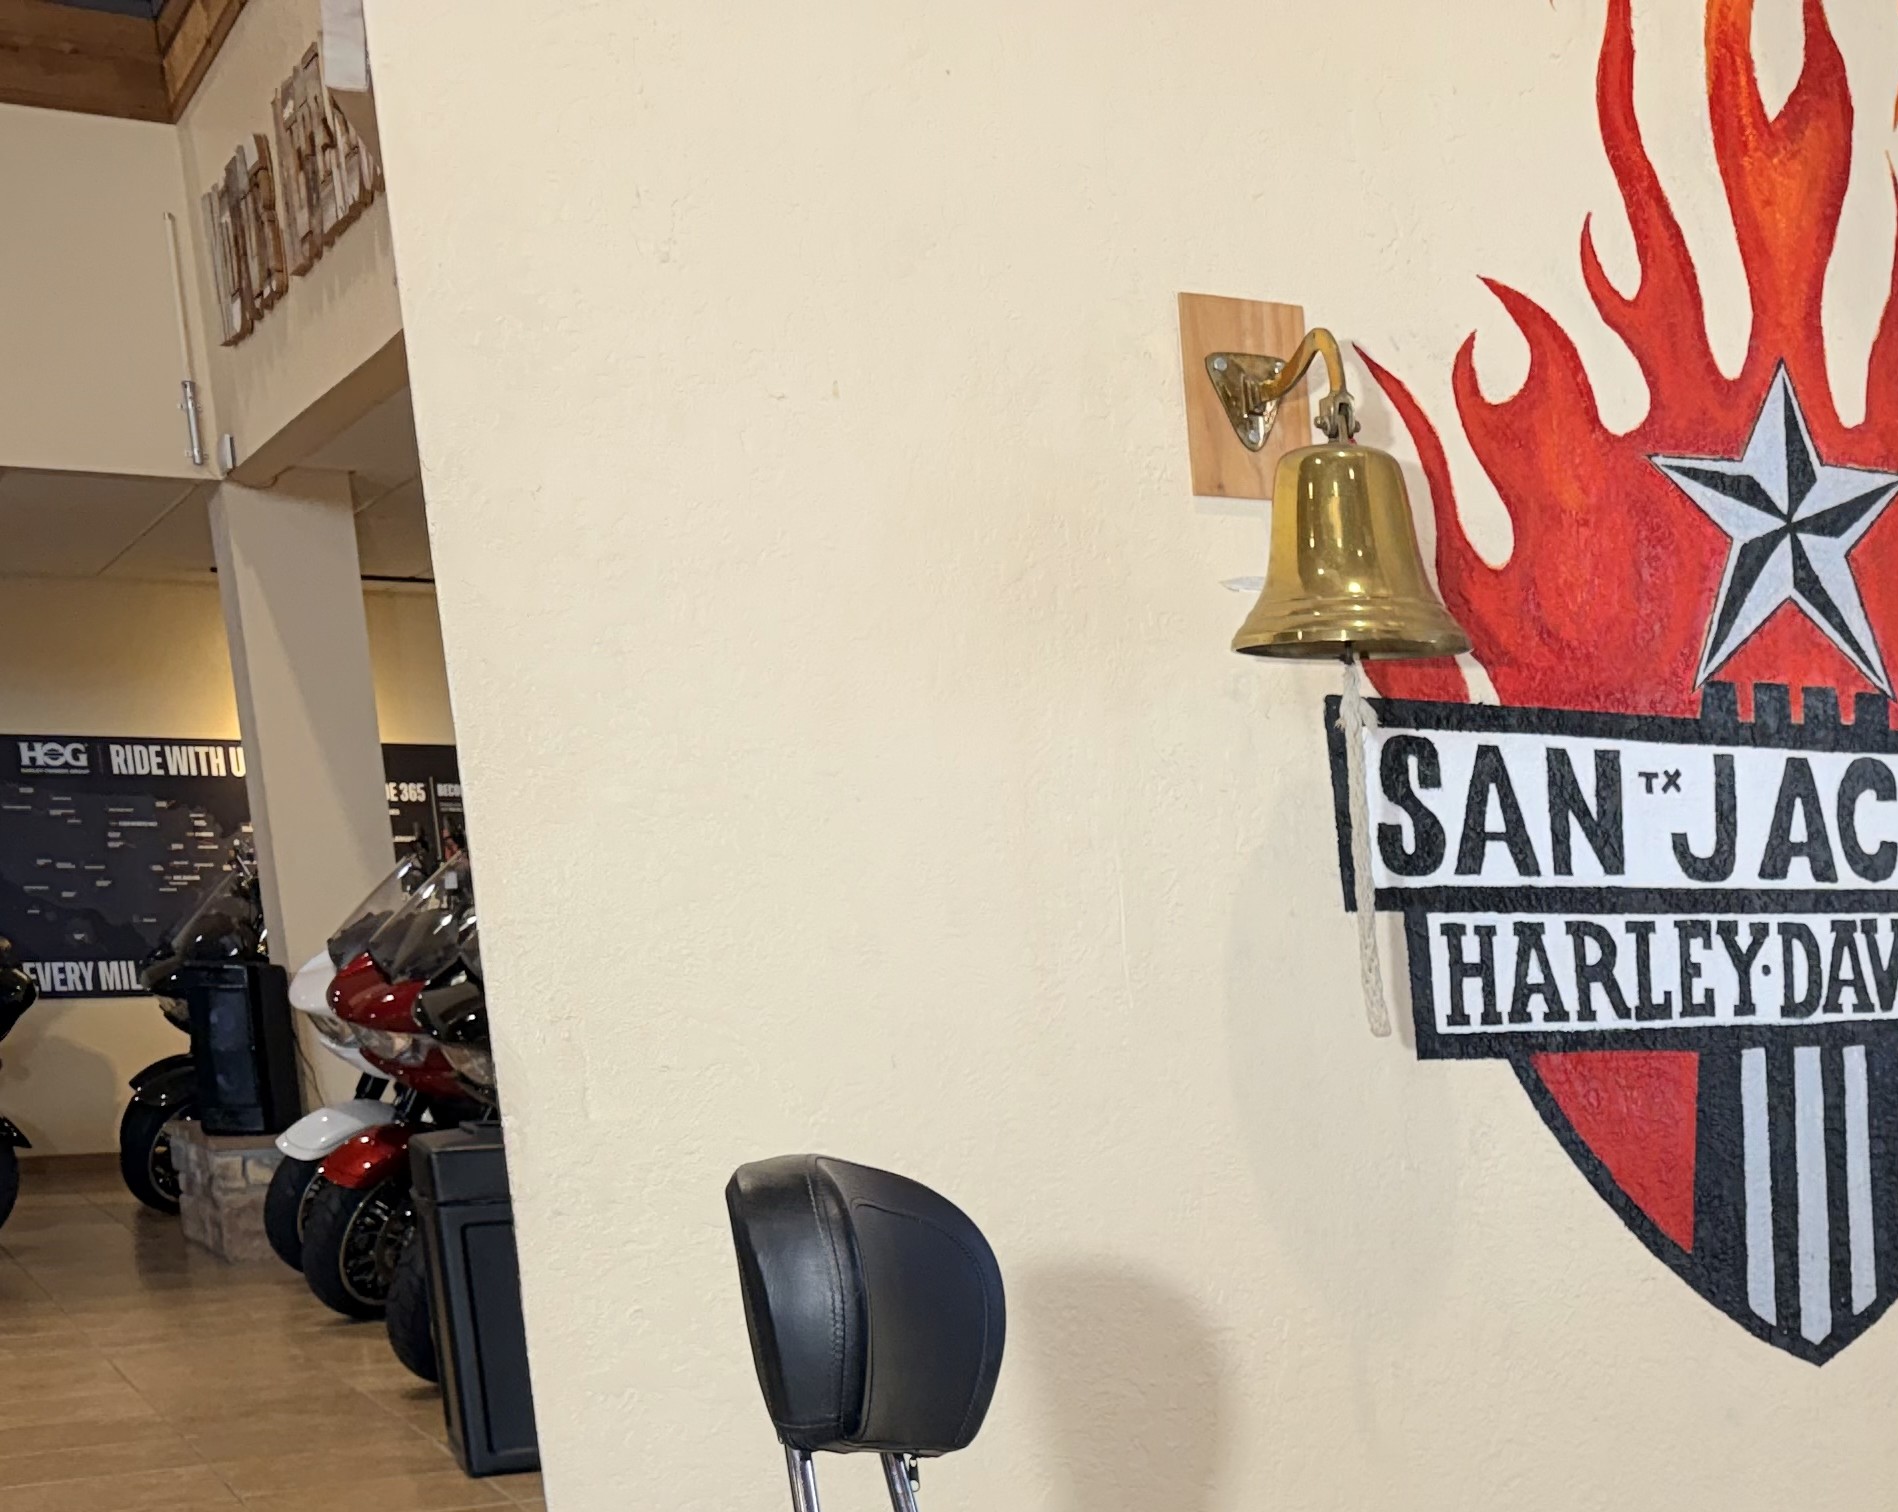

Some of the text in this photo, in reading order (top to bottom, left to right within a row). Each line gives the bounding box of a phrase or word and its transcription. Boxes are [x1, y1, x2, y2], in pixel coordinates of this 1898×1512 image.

[18, 742, 88, 767] HOG
[109, 744, 165, 775] RIDE
[164, 746, 227, 777] WITH
[399, 782, 426, 802] 365
[1377, 735, 1625, 877] SAN
[1638, 769, 1681, 795] TX
[22, 960, 150, 992] EVERY MIL
